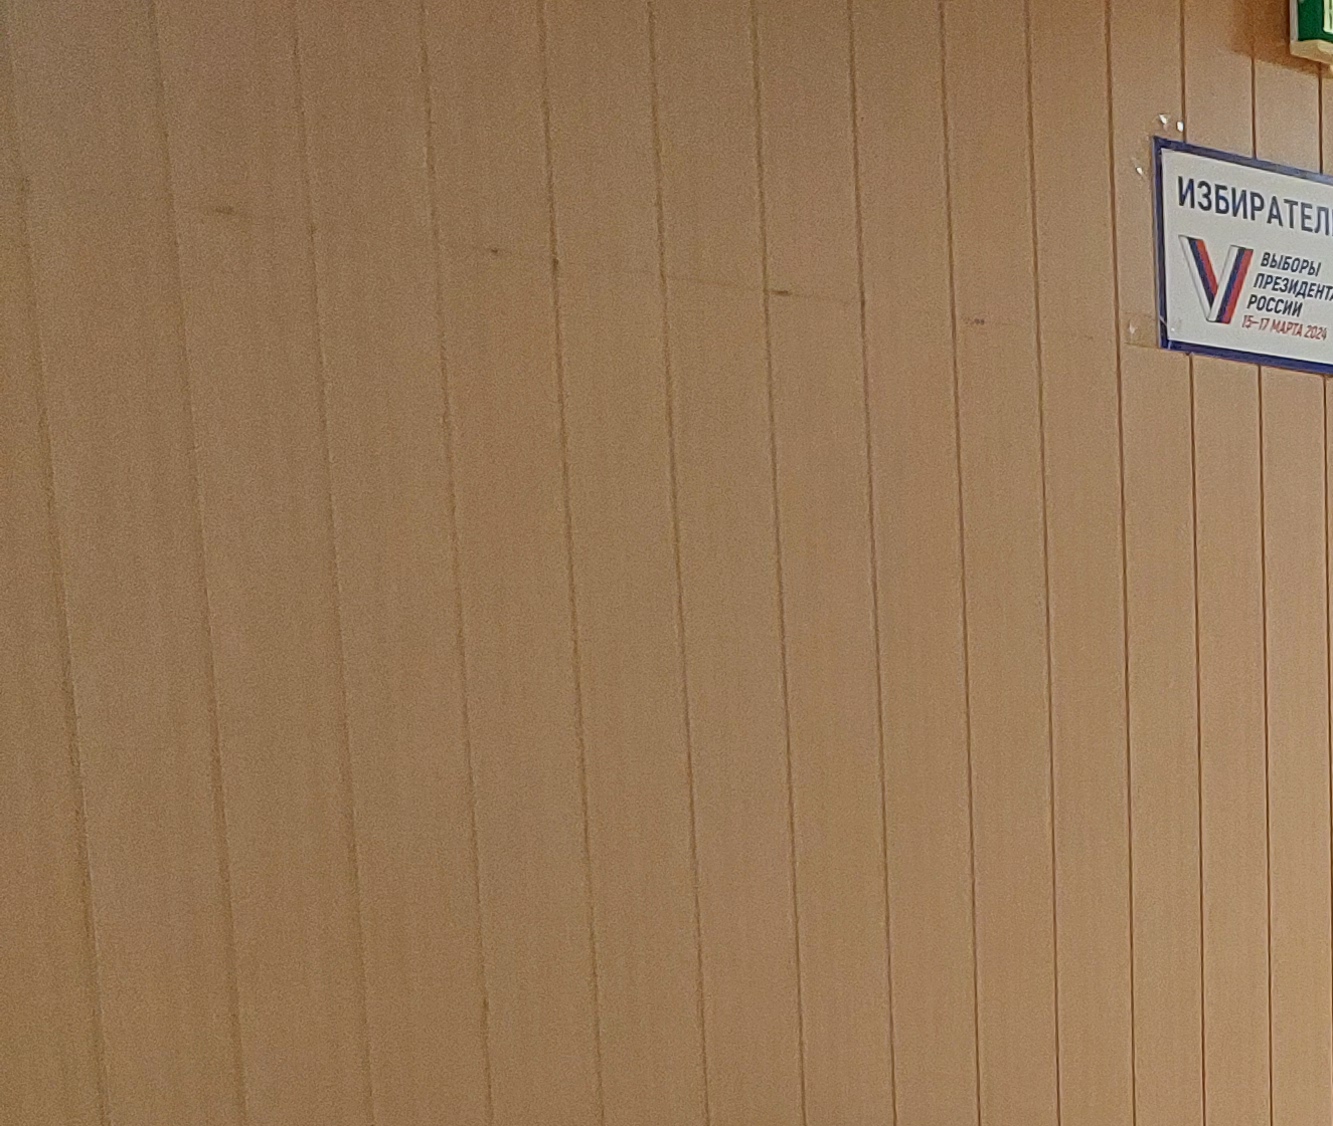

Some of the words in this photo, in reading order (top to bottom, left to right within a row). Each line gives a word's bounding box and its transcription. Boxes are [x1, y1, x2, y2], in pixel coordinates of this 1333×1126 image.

[1260, 251, 1322, 277] ВЫБОРЫ
[1246, 293, 1303, 318] РОССИИ
[1271, 318, 1304, 337] МАРТА
[1304, 323, 1328, 341] 2024
